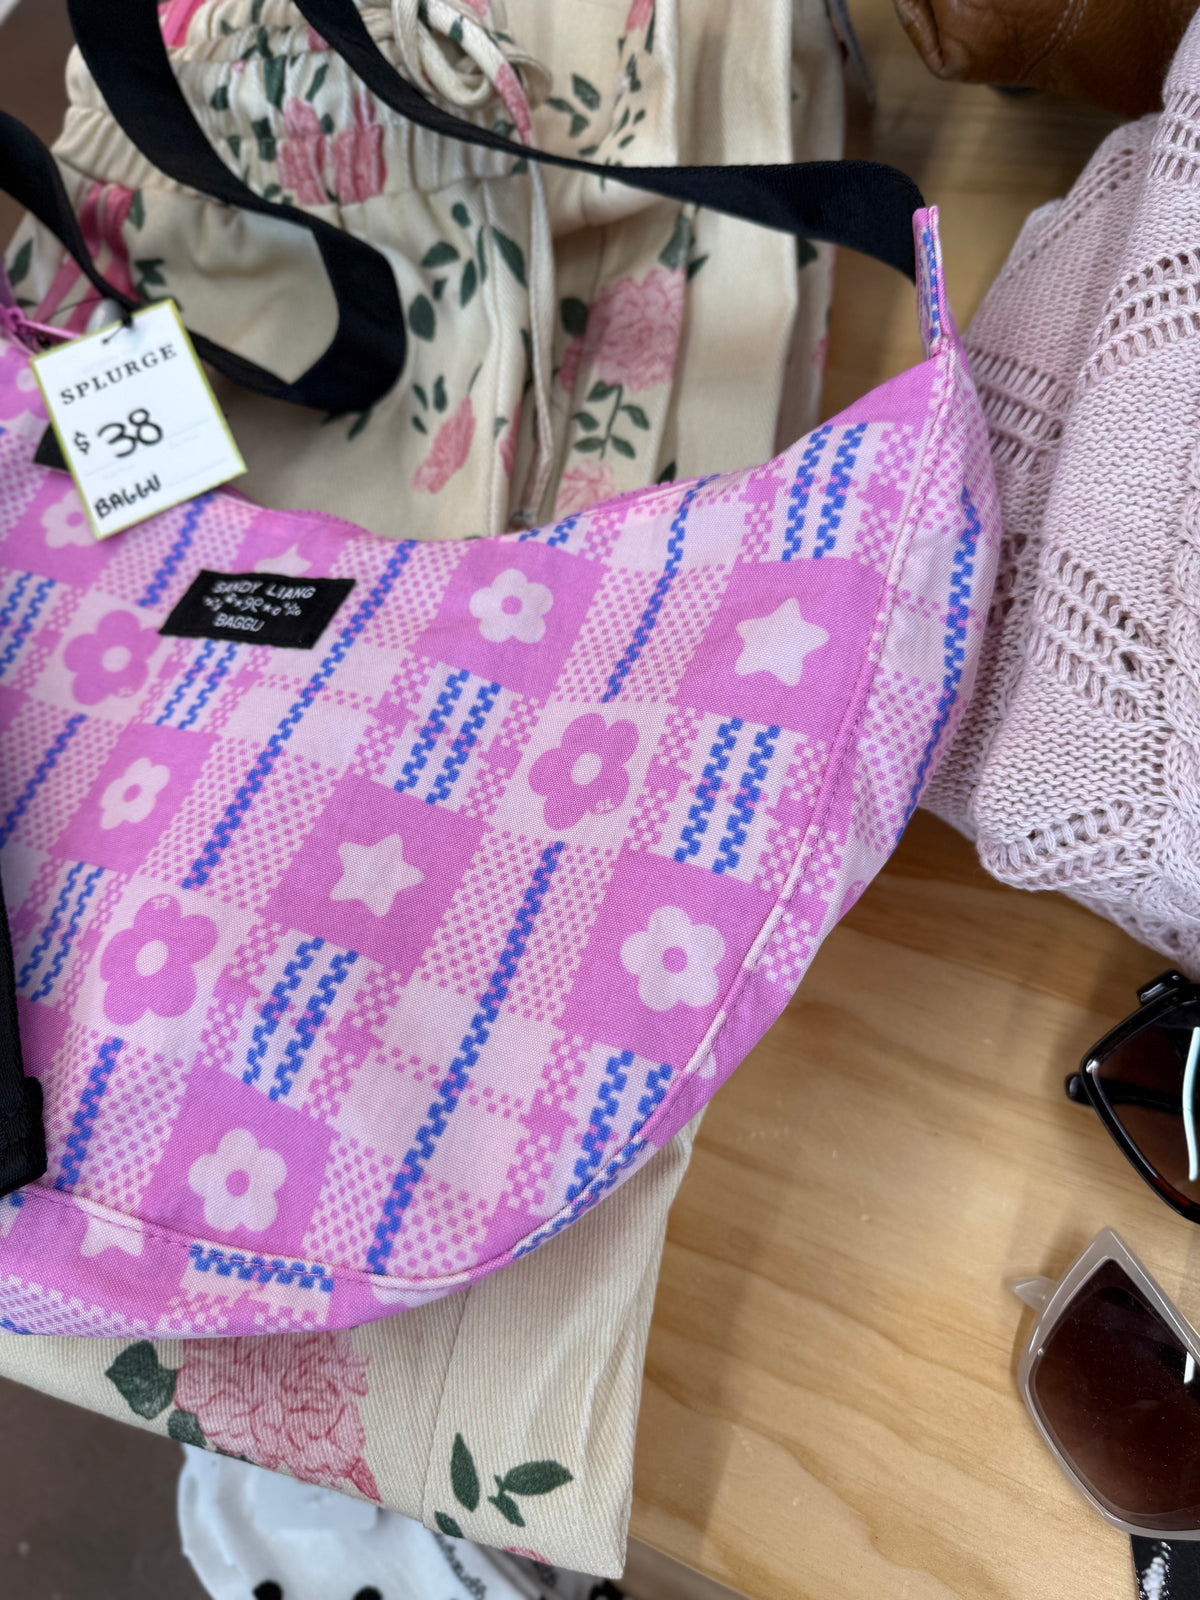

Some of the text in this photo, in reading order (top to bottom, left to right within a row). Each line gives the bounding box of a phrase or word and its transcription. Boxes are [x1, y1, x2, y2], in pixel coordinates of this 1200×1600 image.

[60, 344, 177, 405] SPLURGE
[74, 431, 91, 455] $
[97, 408, 163, 458] 38
[213, 580, 316, 599] SANDY LIANG
[214, 613, 264, 632] BAGGU
